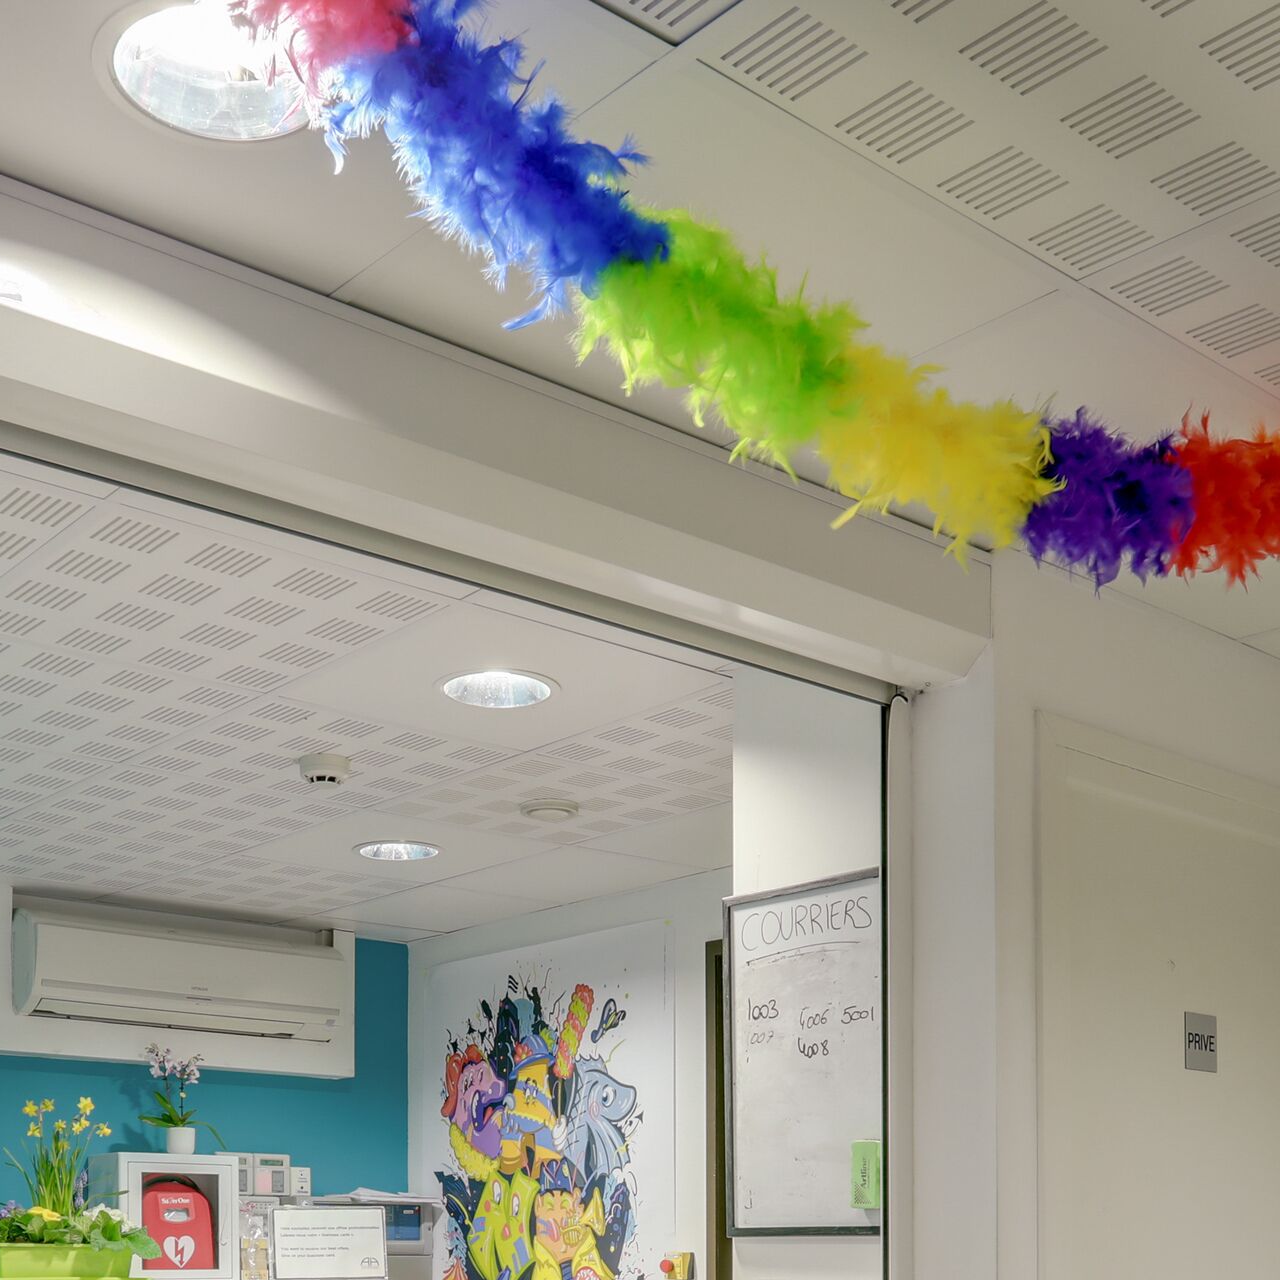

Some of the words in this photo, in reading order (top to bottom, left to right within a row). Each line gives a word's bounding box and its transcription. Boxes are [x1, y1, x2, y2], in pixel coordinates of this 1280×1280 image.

[741, 896, 873, 951] COURRIERS
[748, 997, 779, 1020] 1003
[840, 1005, 874, 1024] 5001
[1188, 1032, 1215, 1052] PRIVE
